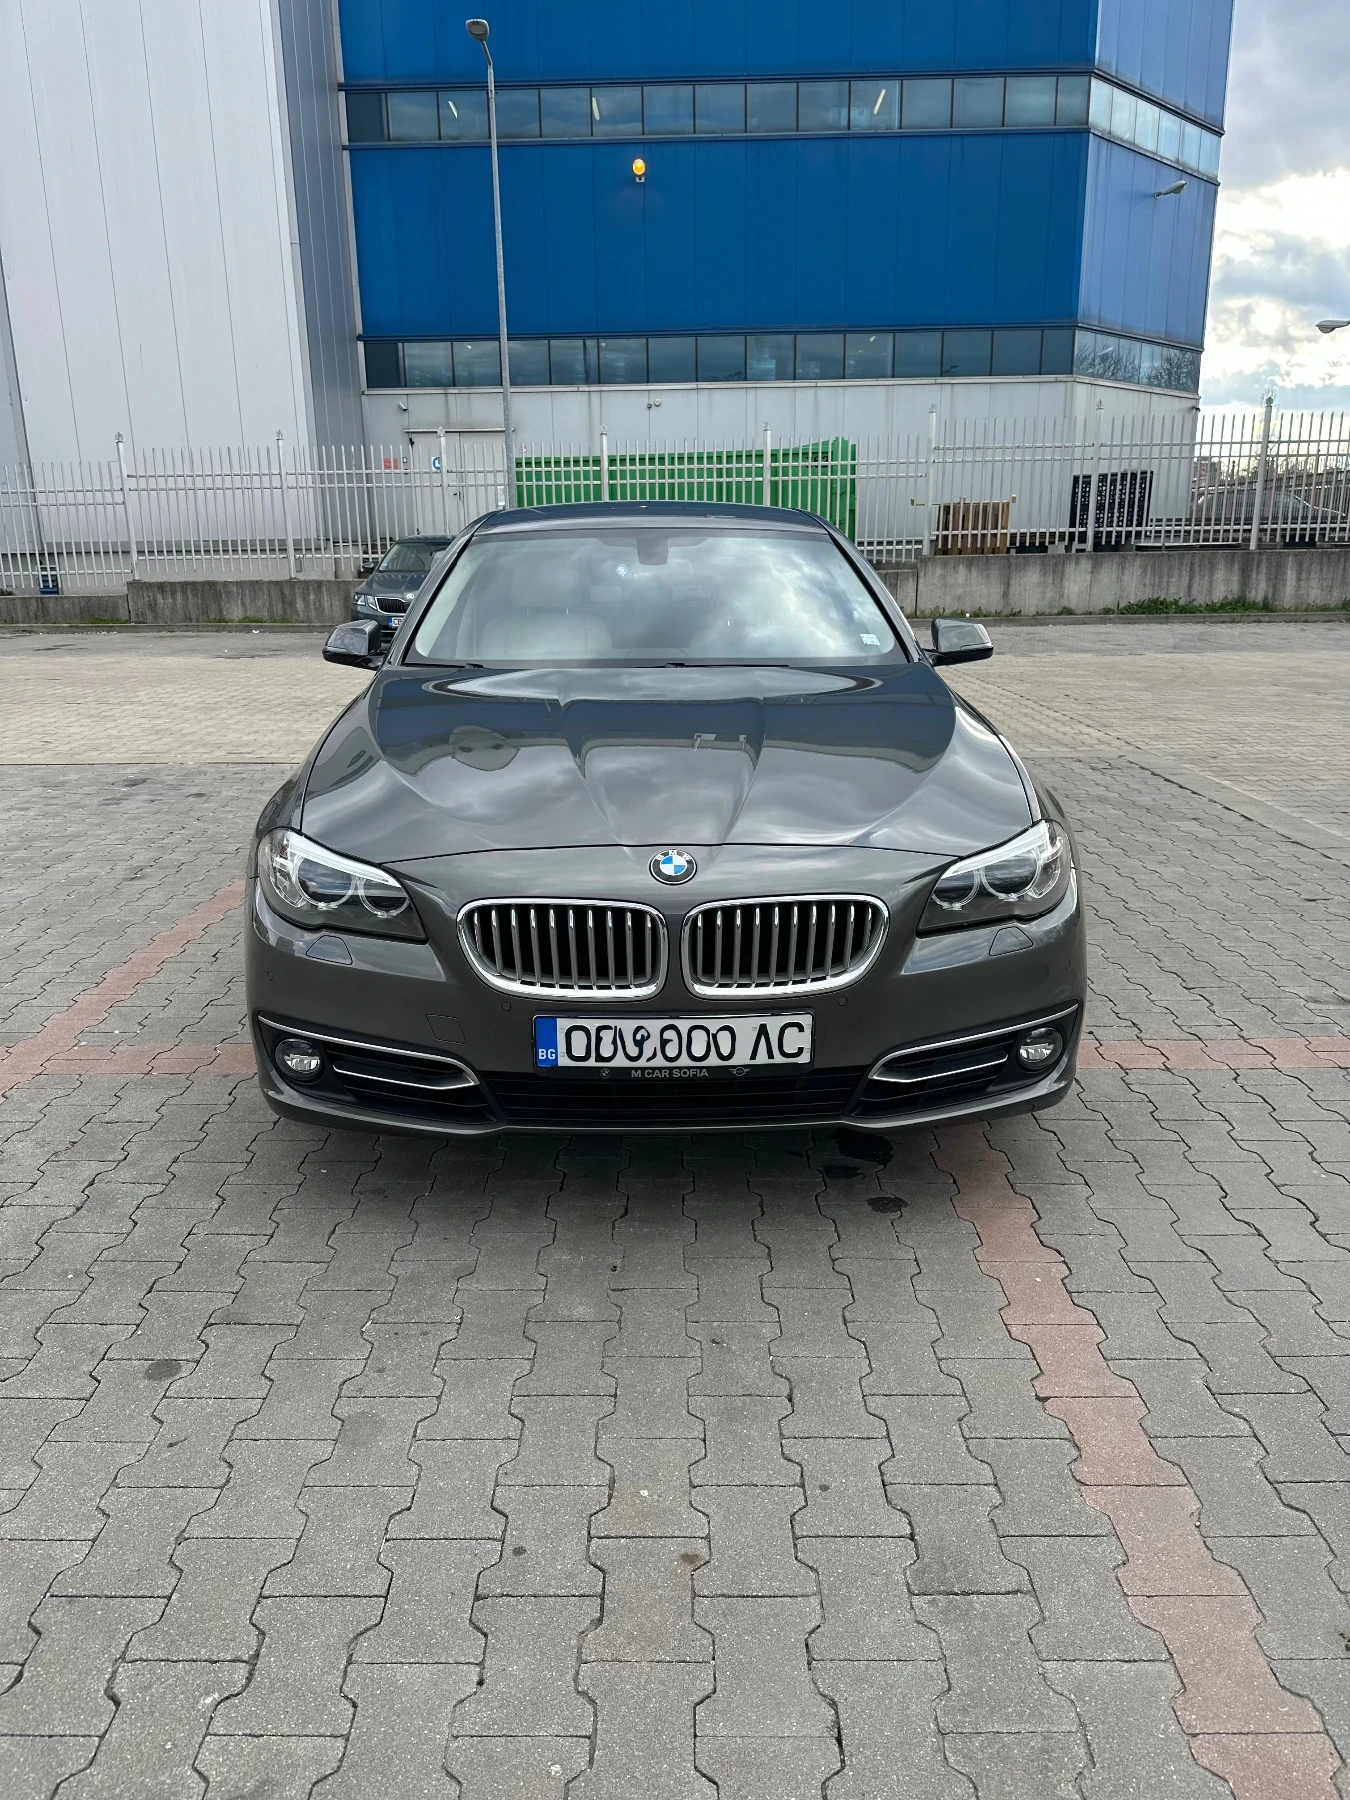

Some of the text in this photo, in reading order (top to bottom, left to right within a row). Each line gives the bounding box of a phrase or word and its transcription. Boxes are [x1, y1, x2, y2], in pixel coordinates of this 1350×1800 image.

[538, 1048, 556, 1060] BG
[631, 1068, 709, 1078] M CAR SOFIA
